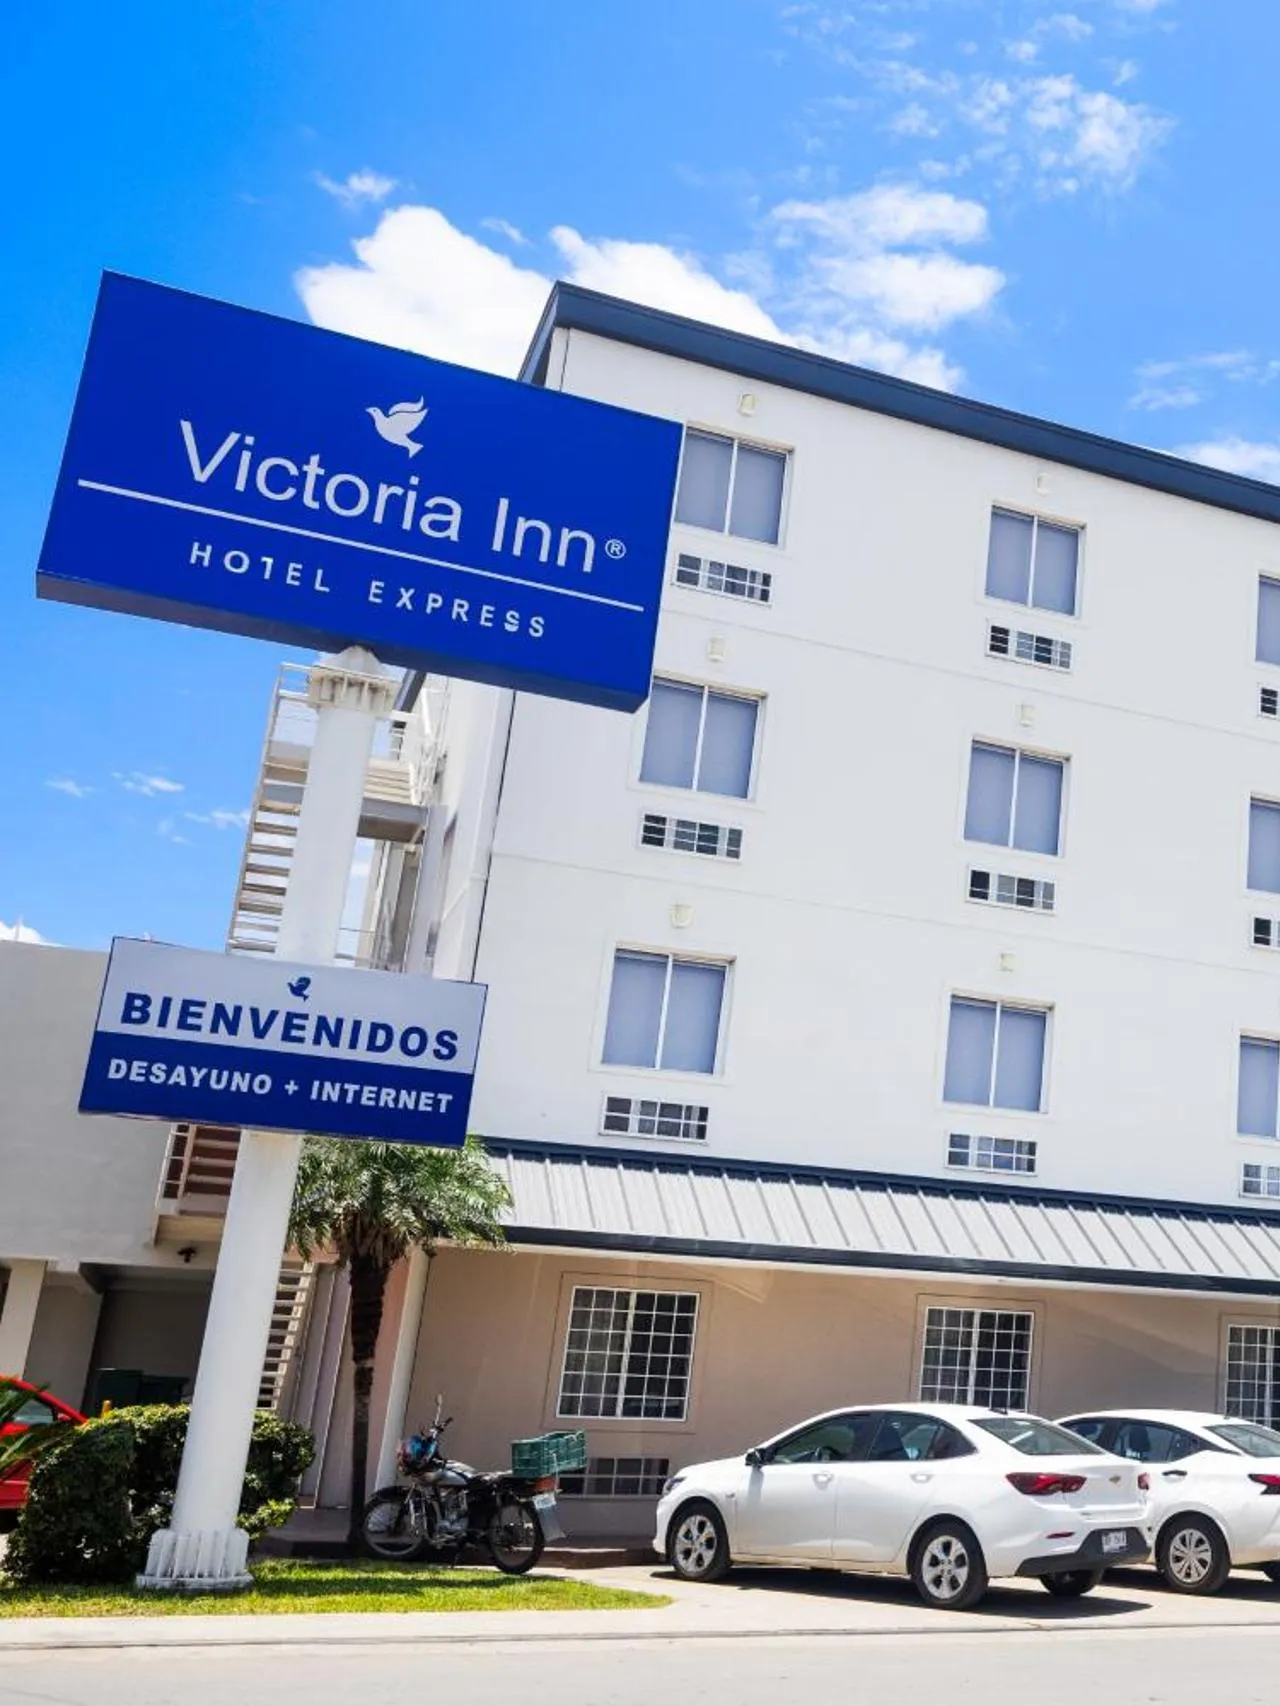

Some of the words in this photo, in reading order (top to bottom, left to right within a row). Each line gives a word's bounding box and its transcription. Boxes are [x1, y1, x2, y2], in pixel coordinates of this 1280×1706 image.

[178, 419, 463, 542] Victoria
[189, 541, 330, 593] HOTEL
[367, 580, 546, 638] EXPRESS
[120, 992, 459, 1061] BIENVENIDOS
[107, 1058, 272, 1095] DESAYUNO
[310, 1080, 453, 1113] INTERNET
